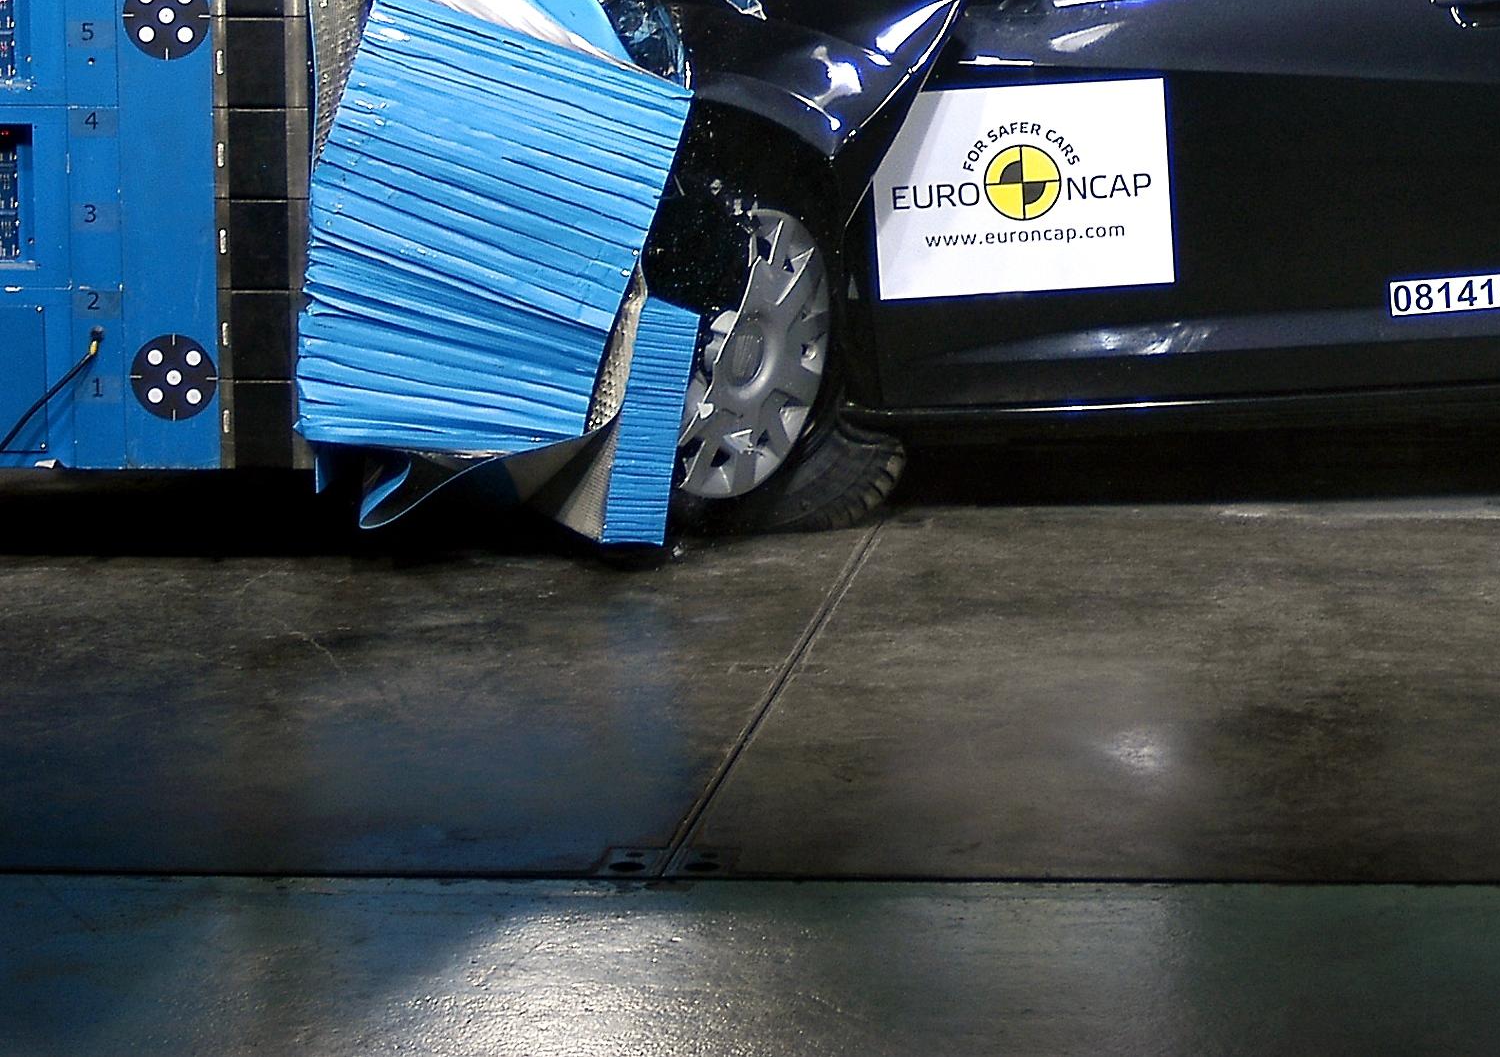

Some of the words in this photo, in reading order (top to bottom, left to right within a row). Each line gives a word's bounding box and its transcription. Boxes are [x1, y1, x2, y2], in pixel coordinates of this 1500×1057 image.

[81, 22, 94, 41] 5
[84, 111, 99, 131] 4
[962, 139, 988, 172] FOR
[986, 121, 1041, 143] SAFER
[1044, 128, 1080, 166] CARS
[891, 181, 980, 211] EURO
[1065, 172, 1152, 201] NCAP
[83, 204, 97, 223] 3
[925, 223, 1125, 247] www.euroncap.com
[87, 291, 100, 310] 2
[92, 377, 104, 398] 1
